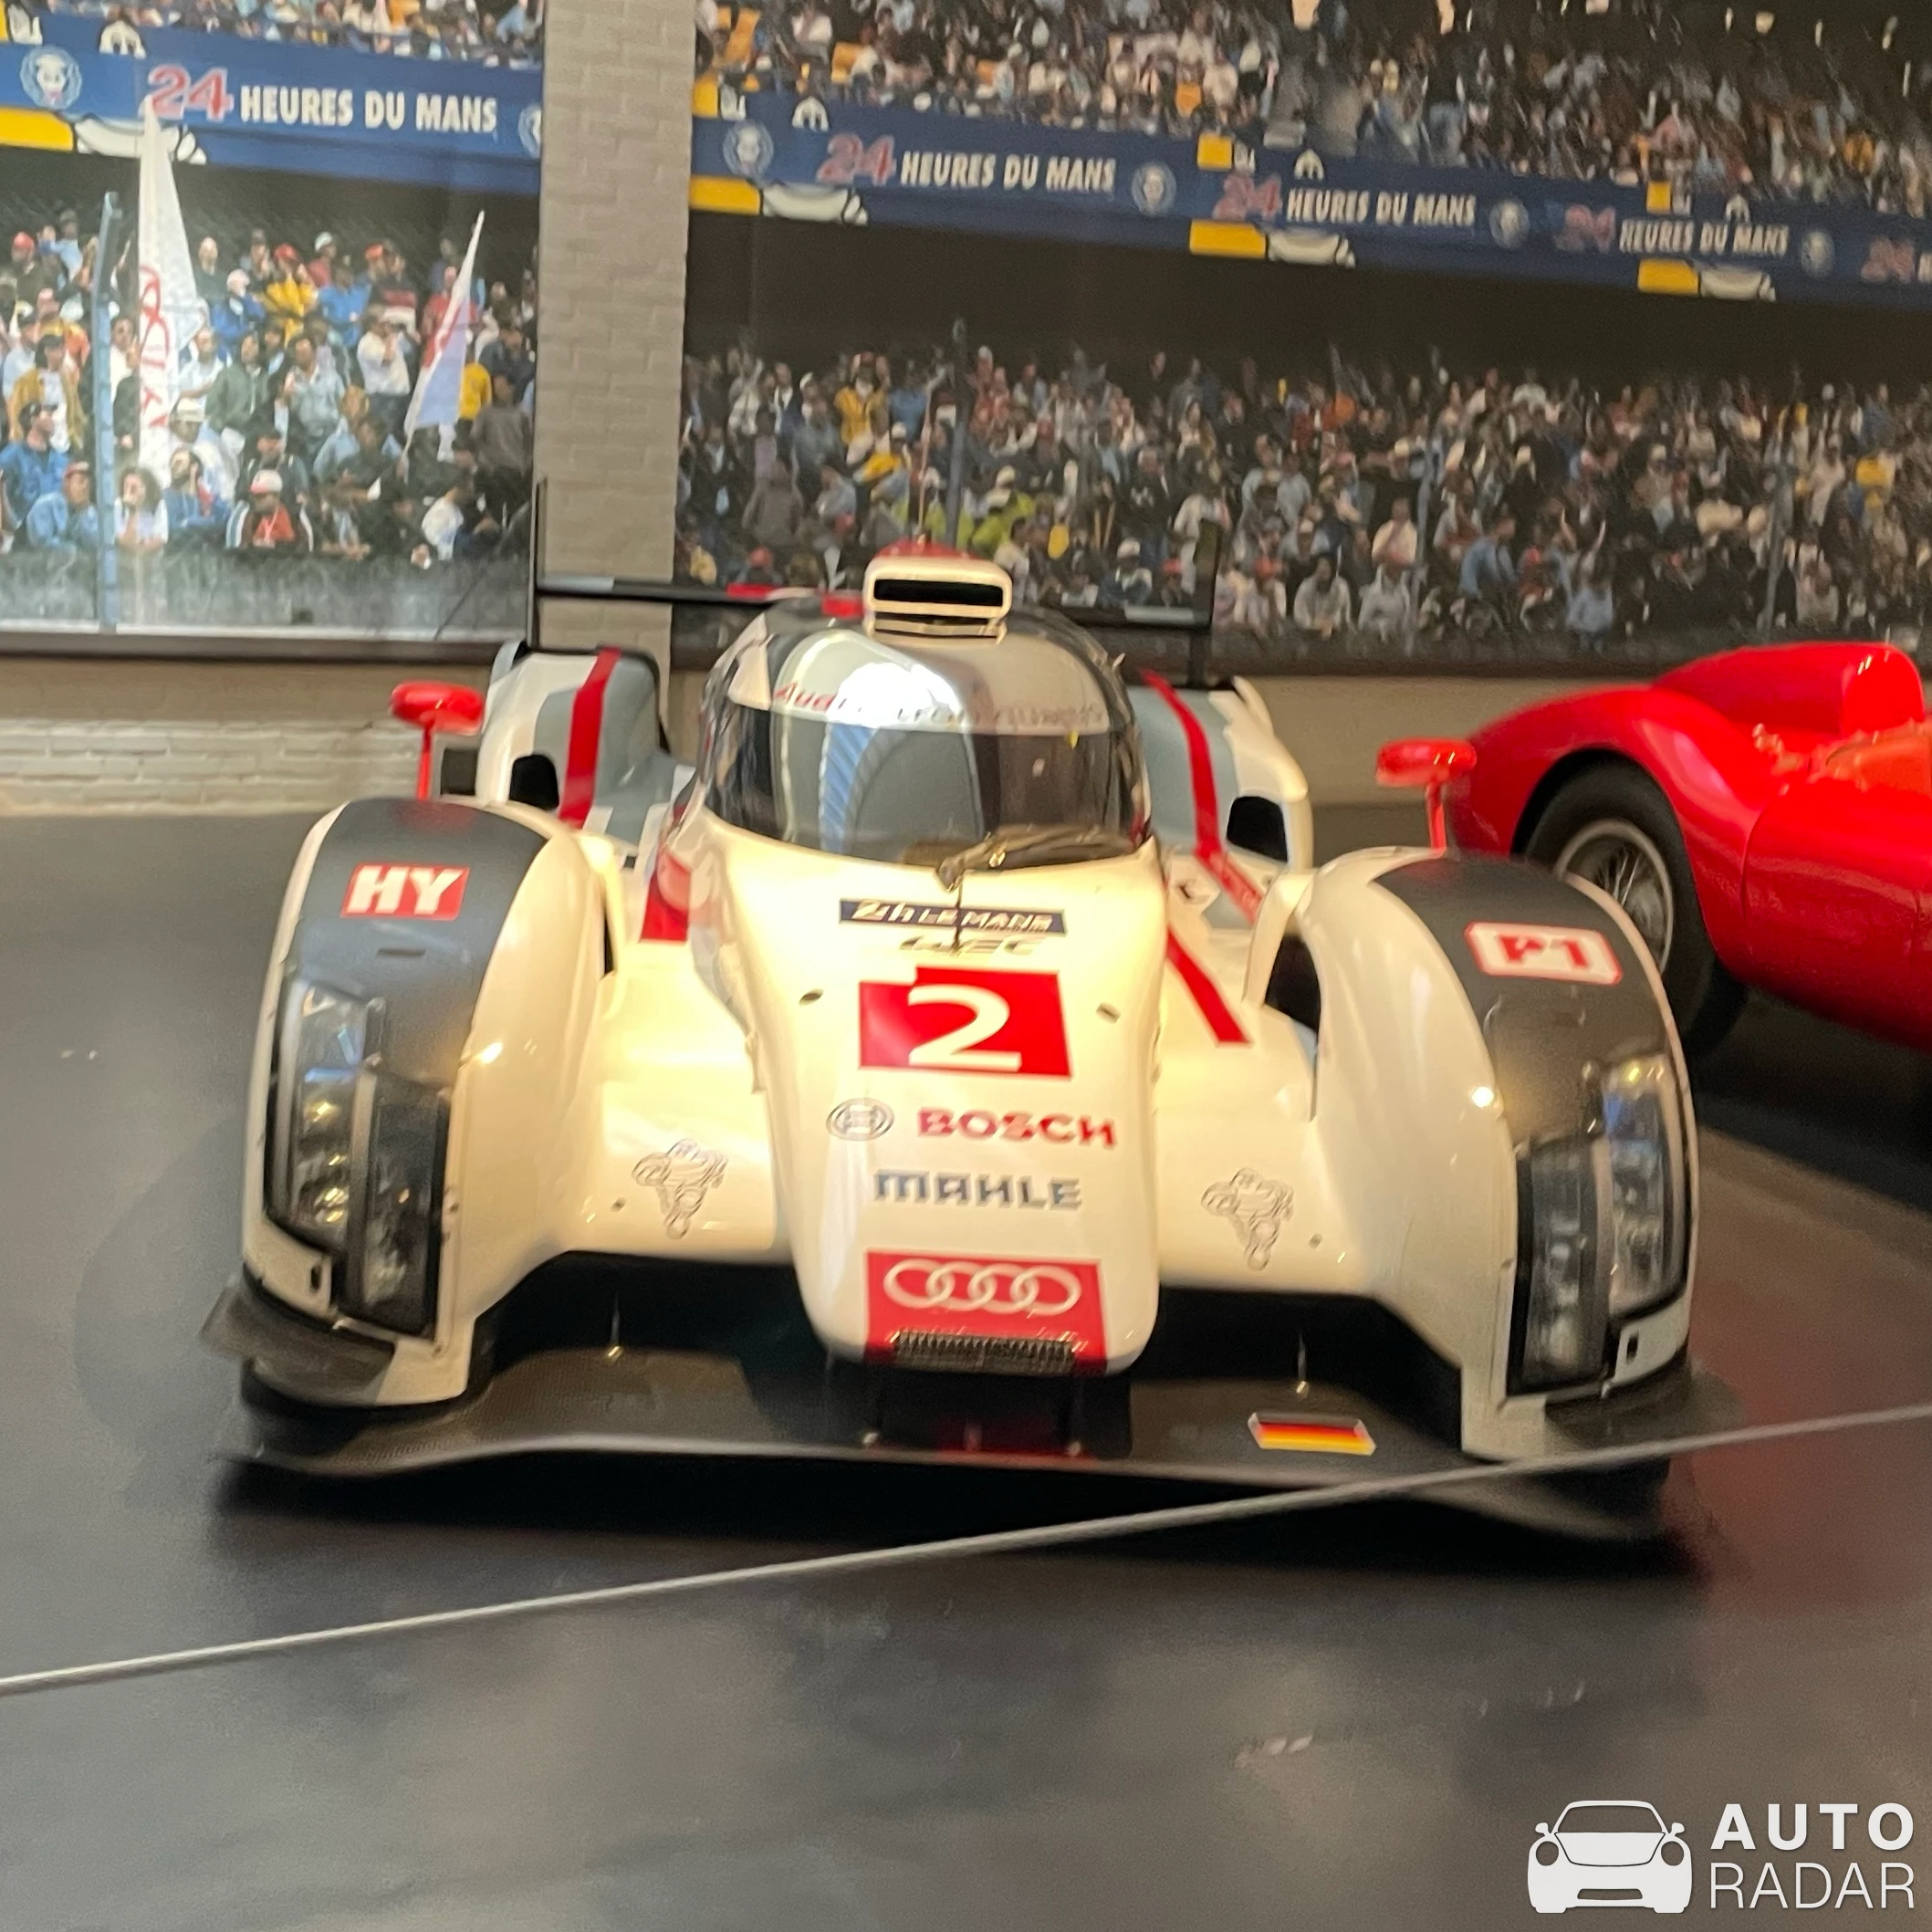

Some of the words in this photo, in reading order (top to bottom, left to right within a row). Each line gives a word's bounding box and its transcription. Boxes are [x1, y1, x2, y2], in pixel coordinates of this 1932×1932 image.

[147, 64, 233, 121] 24
[240, 86, 353, 126] HEURES
[365, 91, 405, 129] DU
[415, 96, 497, 133] MANS
[818, 132, 896, 184] 24
[901, 151, 997, 188] HEURES
[1004, 154, 1038, 191] DU
[1046, 156, 1115, 193] MANS
[1287, 187, 1369, 224] HEURES
[1375, 191, 1409, 227] DU
[1413, 193, 1477, 227] MANS
[347, 865, 465, 914] HY
[907, 984, 1023, 1072] 2
[916, 1106, 1117, 1150] BOSCH
[872, 1169, 1083, 1211] MAHLE
